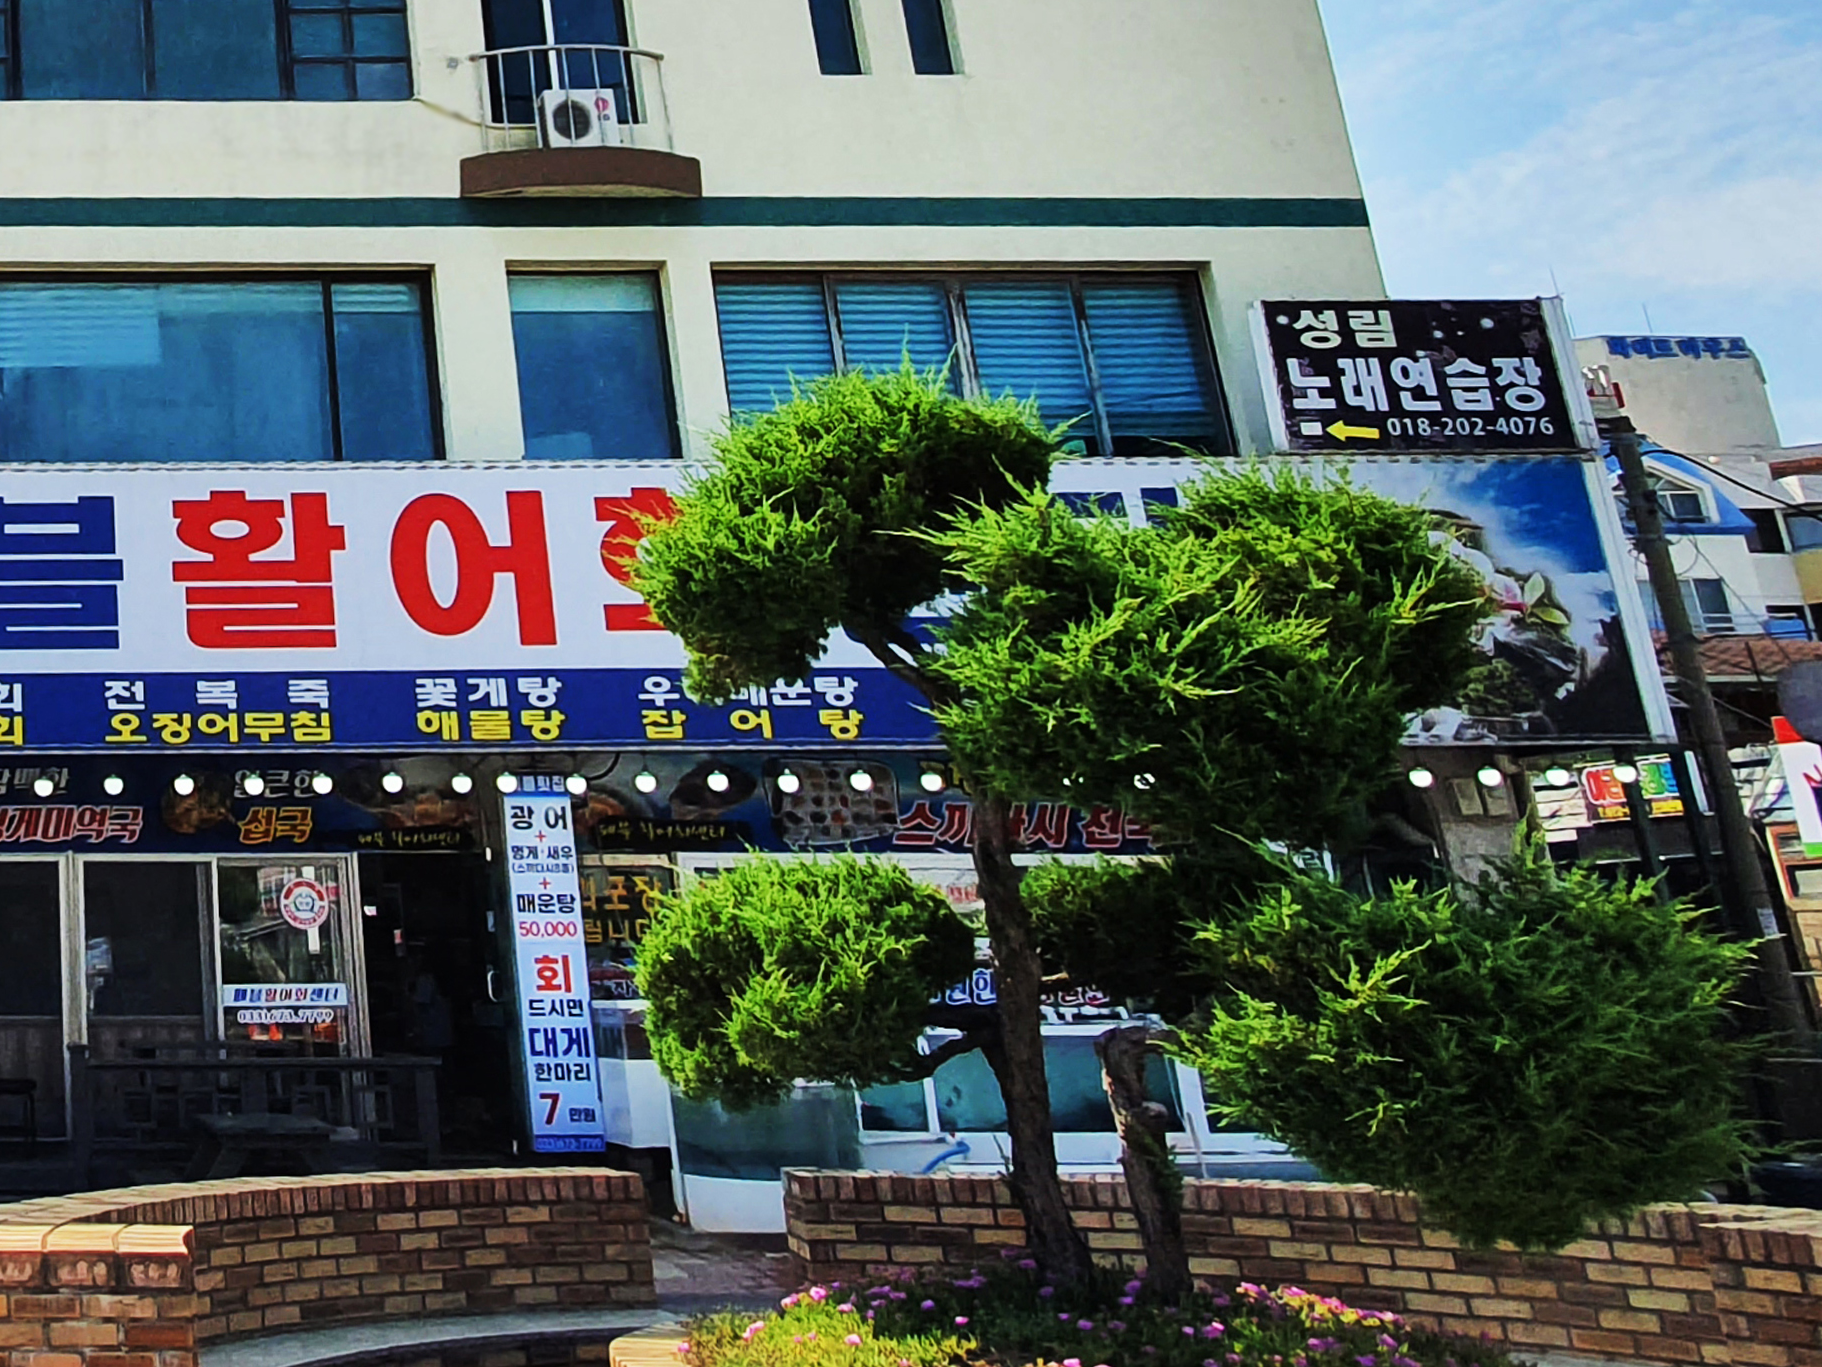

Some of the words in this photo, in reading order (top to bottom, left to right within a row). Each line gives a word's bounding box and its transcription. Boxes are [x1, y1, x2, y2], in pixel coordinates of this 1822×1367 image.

[1293, 309, 1398, 349] 성림
[1286, 356, 1546, 412] 노래연습장
[1386, 417, 1554, 436] 018-202-4076
[104, 677, 329, 711] 전복죽
[415, 676, 562, 707] 꽃게탕
[637, 676, 858, 707] 우매운탕
[104, 711, 332, 744] 오징어무침
[416, 709, 564, 741] 해물탕
[641, 709, 864, 741] 잡어탕
[510, 805, 568, 830] 광어
[893, 800, 1071, 849] 스끼시
[516, 893, 576, 914] 매운탕
[519, 920, 578, 937] 50,000
[534, 954, 572, 993] 회
[528, 998, 584, 1017] 드시면
[528, 1027, 591, 1058] 대게
[534, 1062, 591, 1082] 한마리
[539, 1093, 560, 1125] 7
